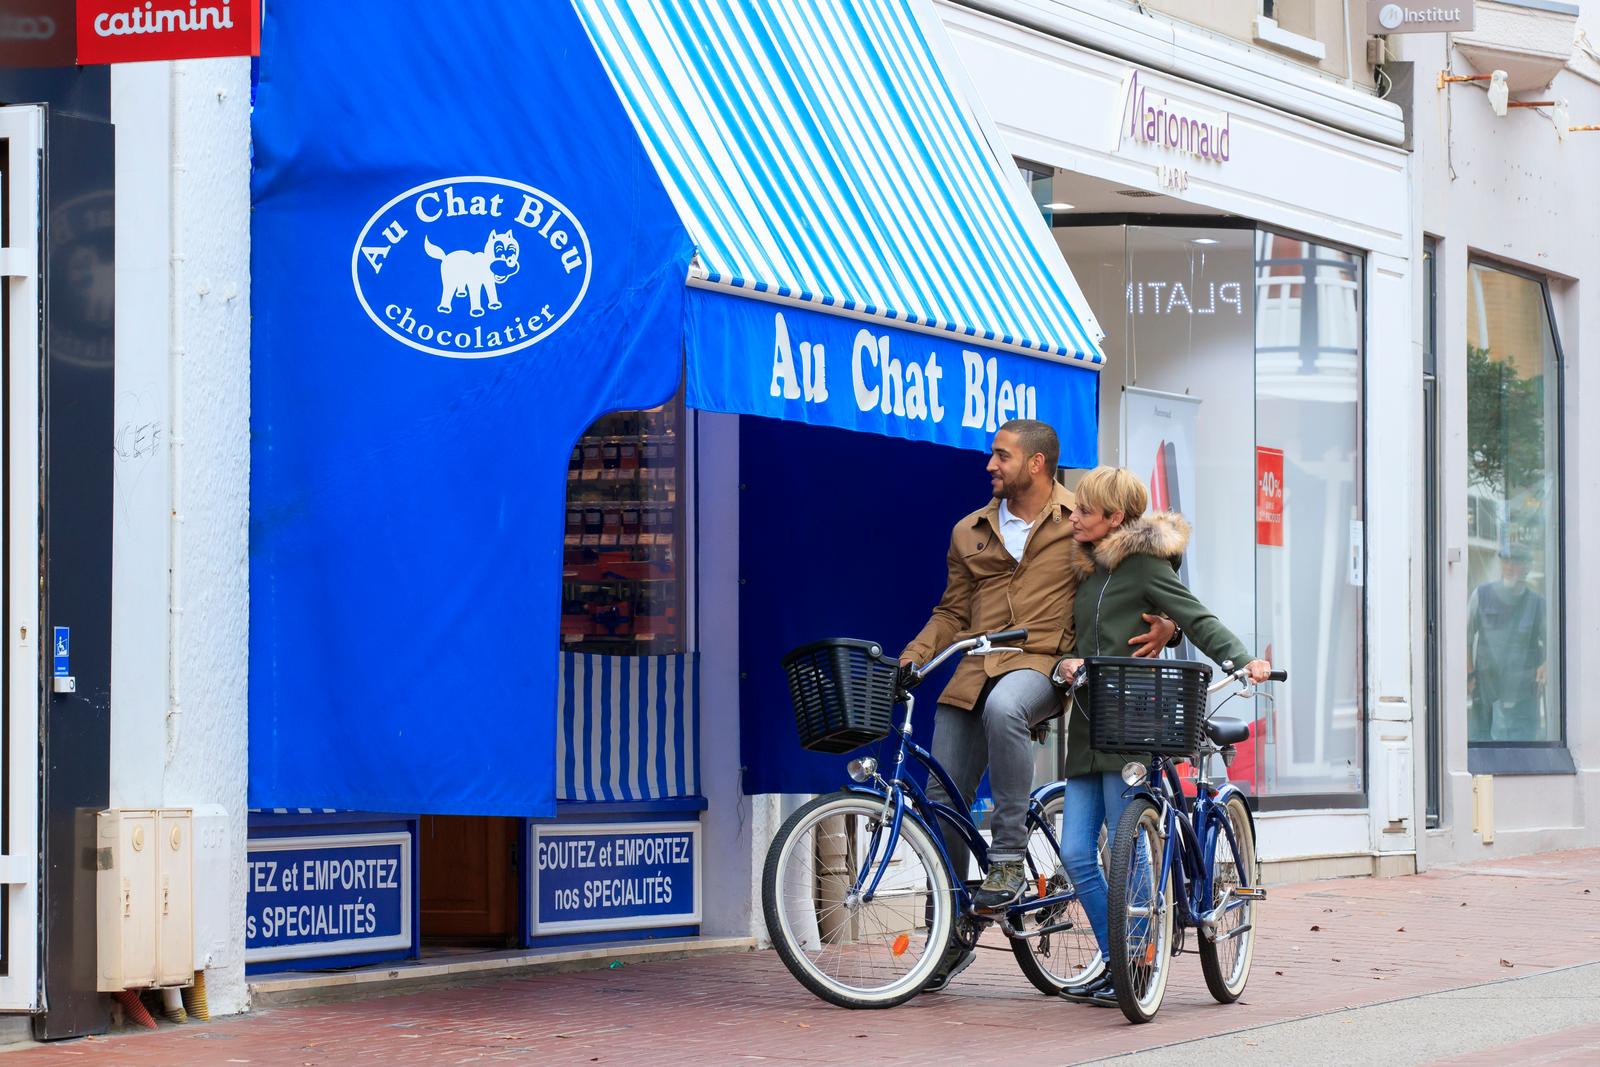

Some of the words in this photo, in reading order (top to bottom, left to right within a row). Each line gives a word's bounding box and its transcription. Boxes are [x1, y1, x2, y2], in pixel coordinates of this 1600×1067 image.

[94, 0, 233, 37] catimini
[1404, 7, 1461, 22] Institut
[1118, 70, 1229, 161] Marionnaud
[361, 220, 408, 274] Au
[415, 187, 503, 223] Chat
[514, 194, 582, 274] Bleu
[385, 303, 555, 349] chocolatier
[770, 312, 828, 403] Au
[852, 329, 944, 423] Chat
[962, 350, 1036, 432] Bleu
[1259, 471, 1282, 498] -40%
[538, 840, 596, 870] GOUTEZ
[599, 840, 612, 867] et
[615, 837, 690, 866] EMPORTEZ
[282, 862, 299, 892] et
[303, 859, 398, 891] EMPORTEZ
[555, 888, 580, 910] nos
[584, 871, 673, 908] SPECIALITÉS
[262, 897, 376, 938] SPECIALITÉS
